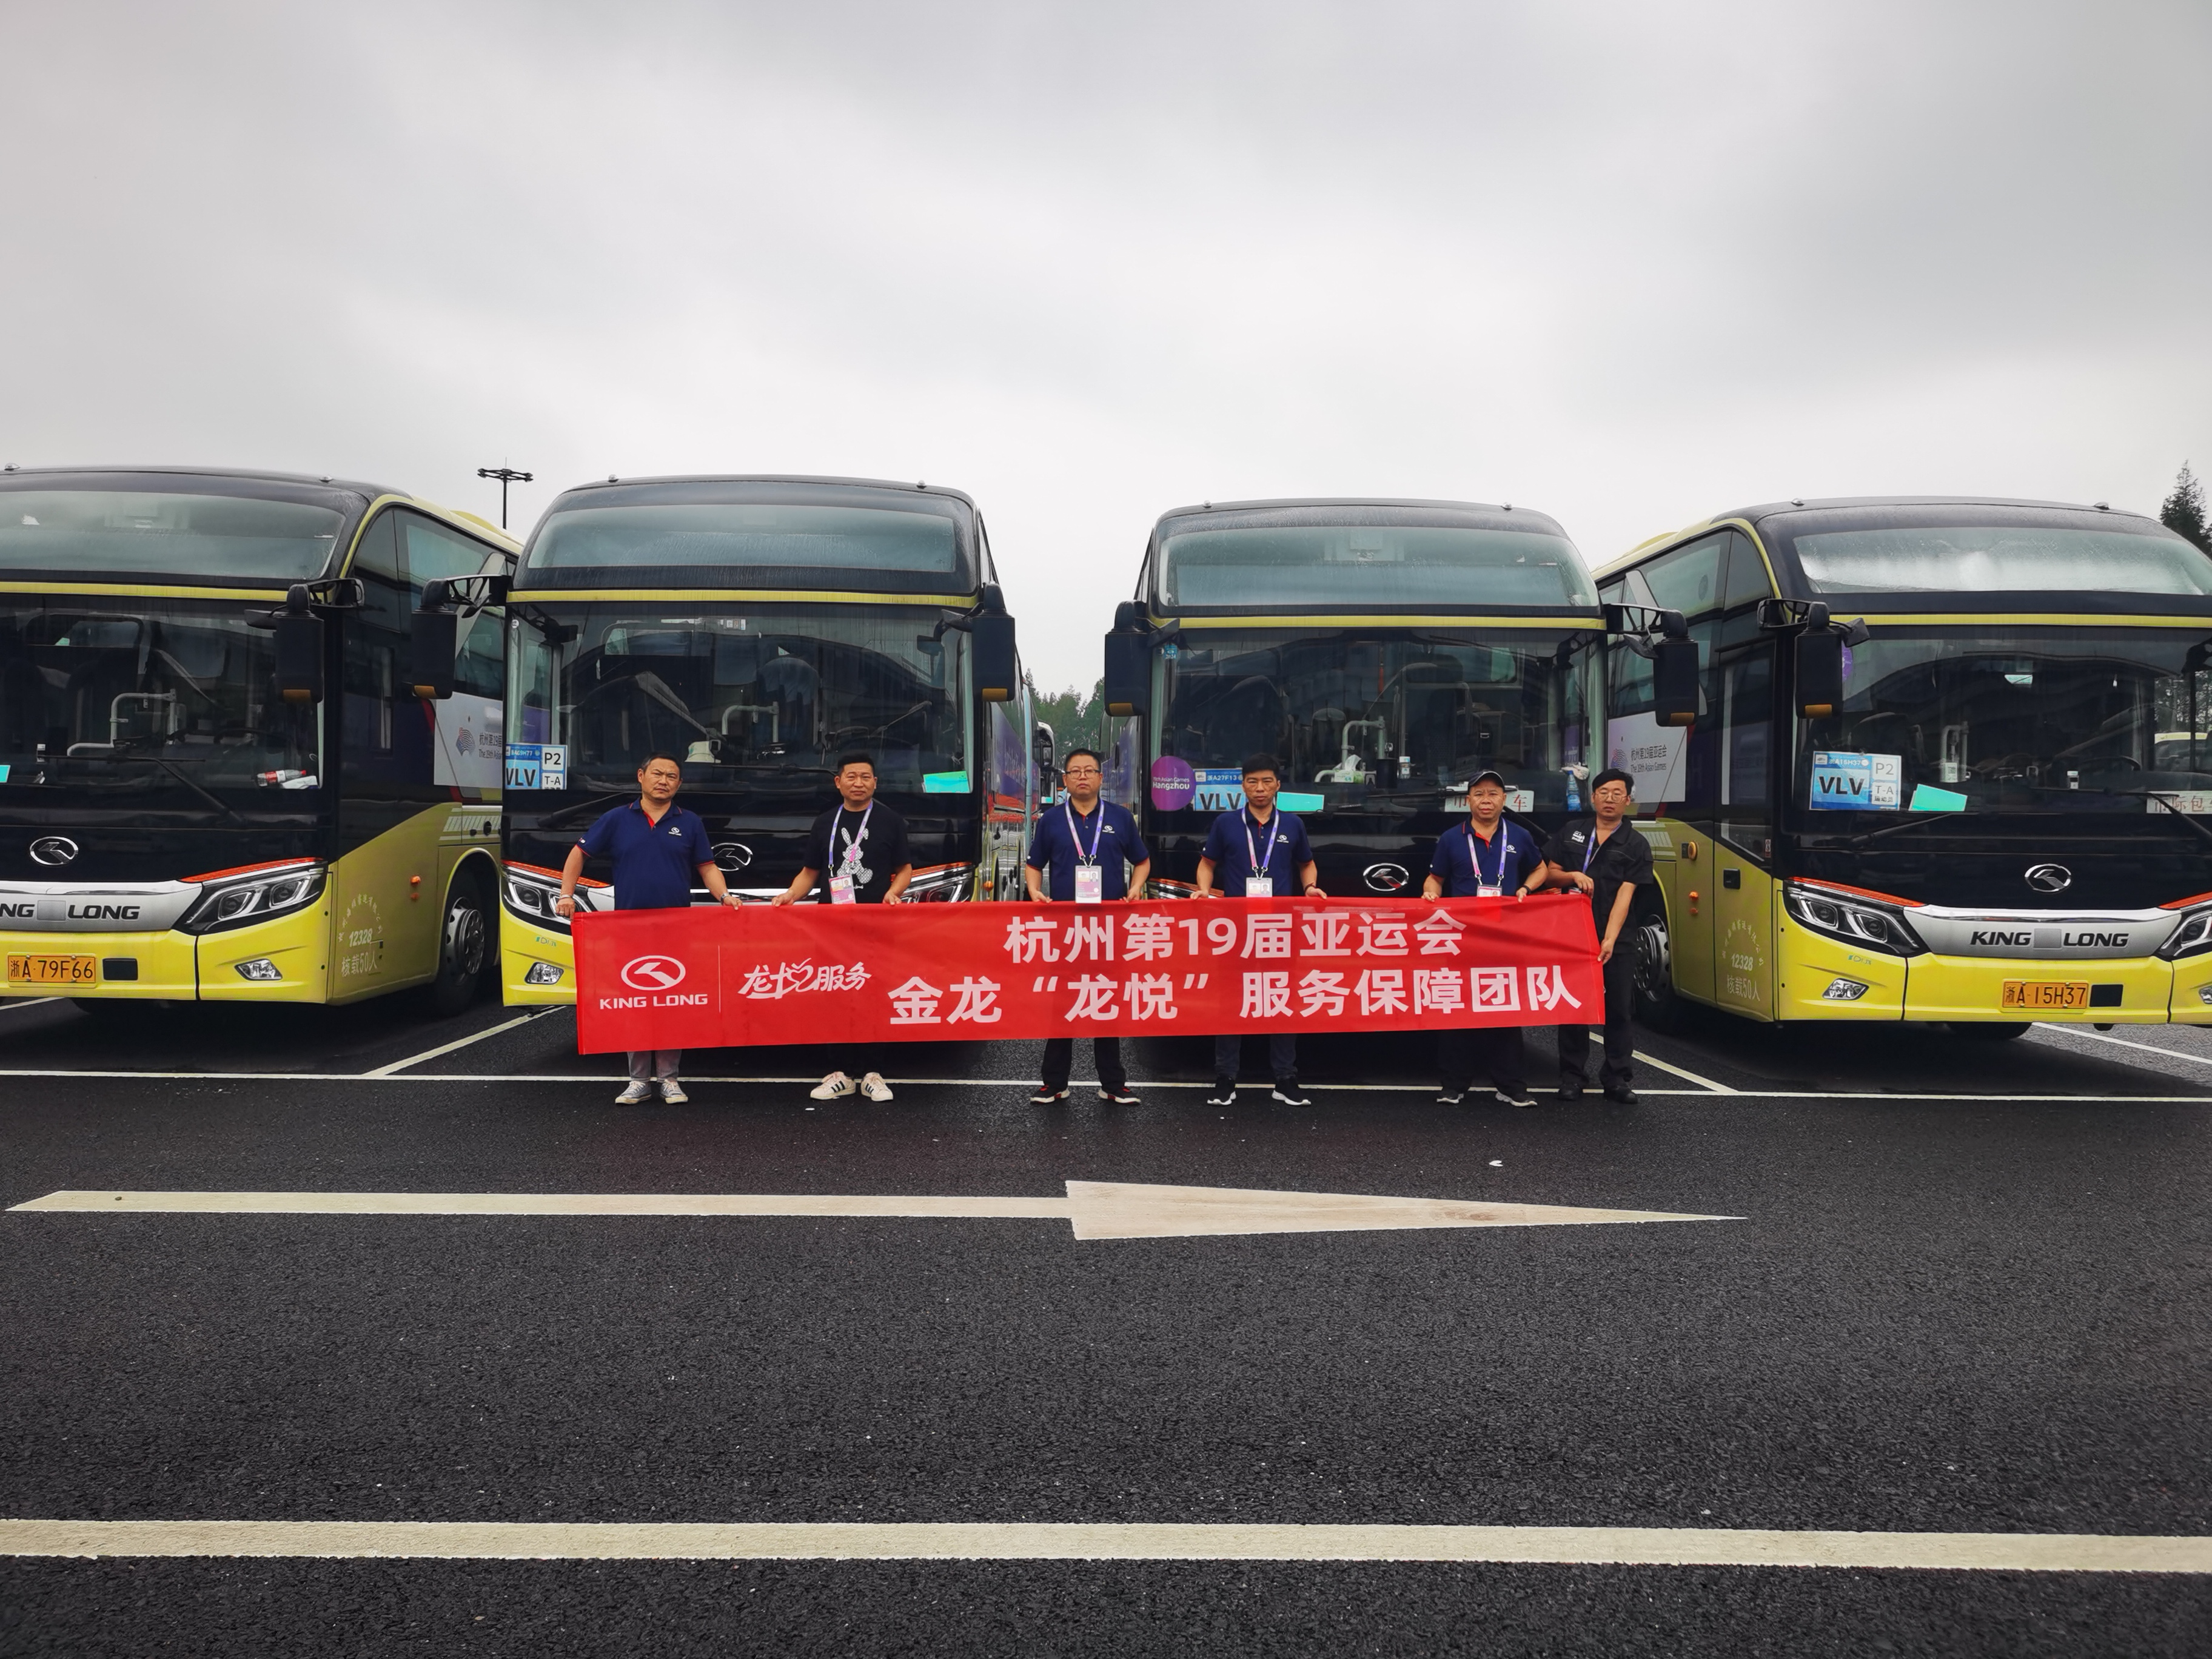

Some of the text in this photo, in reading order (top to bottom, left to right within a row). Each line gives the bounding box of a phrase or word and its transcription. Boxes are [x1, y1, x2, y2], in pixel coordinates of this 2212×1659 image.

[545, 752, 561, 765] P2
[506, 768, 536, 786] VLV
[1875, 763, 1894, 776] P2
[545, 776, 561, 785] T-A
[1153, 782, 1190, 791] Hangzhou
[1819, 776, 1865, 796] VLV
[1875, 785, 1894, 795] T-A
[1199, 793, 1242, 810] VLV
[68, 905, 140, 920] LONG
[349, 928, 373, 947] 12328
[1004, 909, 1467, 964] 杭州第19届亚运会
[1970, 931, 2129, 947] KING LONG
[1731, 953, 1754, 971] 12328
[600, 994, 708, 1010] KING LONG
